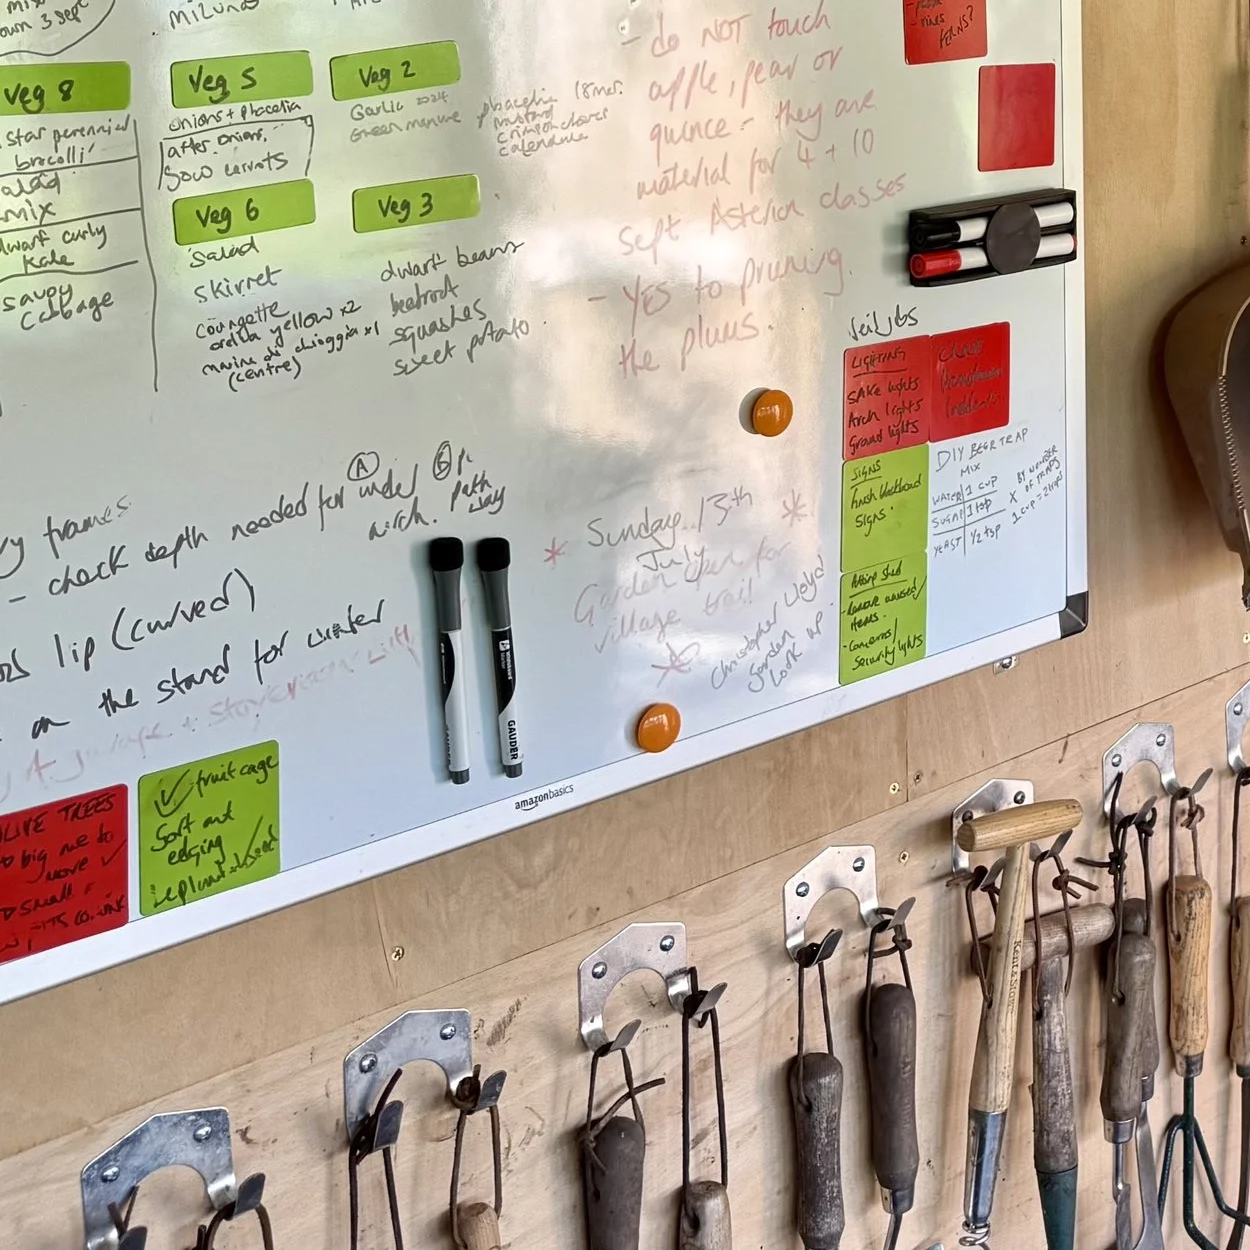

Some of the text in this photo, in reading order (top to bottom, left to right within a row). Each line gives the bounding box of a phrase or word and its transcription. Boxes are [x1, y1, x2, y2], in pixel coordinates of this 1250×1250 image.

[651, 12, 680, 57] do
[701, 13, 752, 47] NOT
[58, 79, 75, 102] 8
[189, 65, 257, 104] Veg 5
[359, 60, 416, 93] Veg 2
[741, 53, 799, 109] pear
[813, 46, 844, 71] or
[650, 88, 876, 167] quince they are
[1, 172, 61, 197] alad
[637, 127, 874, 200] material for 4 10
[378, 192, 434, 224] Veg 3
[819, 172, 907, 210] classes
[196, 197, 260, 234] Veg 6
[0, 230, 50, 255] warf
[695, 247, 844, 306] to pruning
[619, 335, 660, 378] the
[936, 446, 964, 472] DIY
[999, 427, 1028, 446] TRAP
[145, 525, 208, 570] depth
[587, 506, 683, 550] Sunday
[54, 634, 96, 672] lip
[98, 688, 140, 718] the
[157, 643, 231, 704] stand
[254, 630, 289, 685] for
[507, 719, 519, 761] GAUDER
